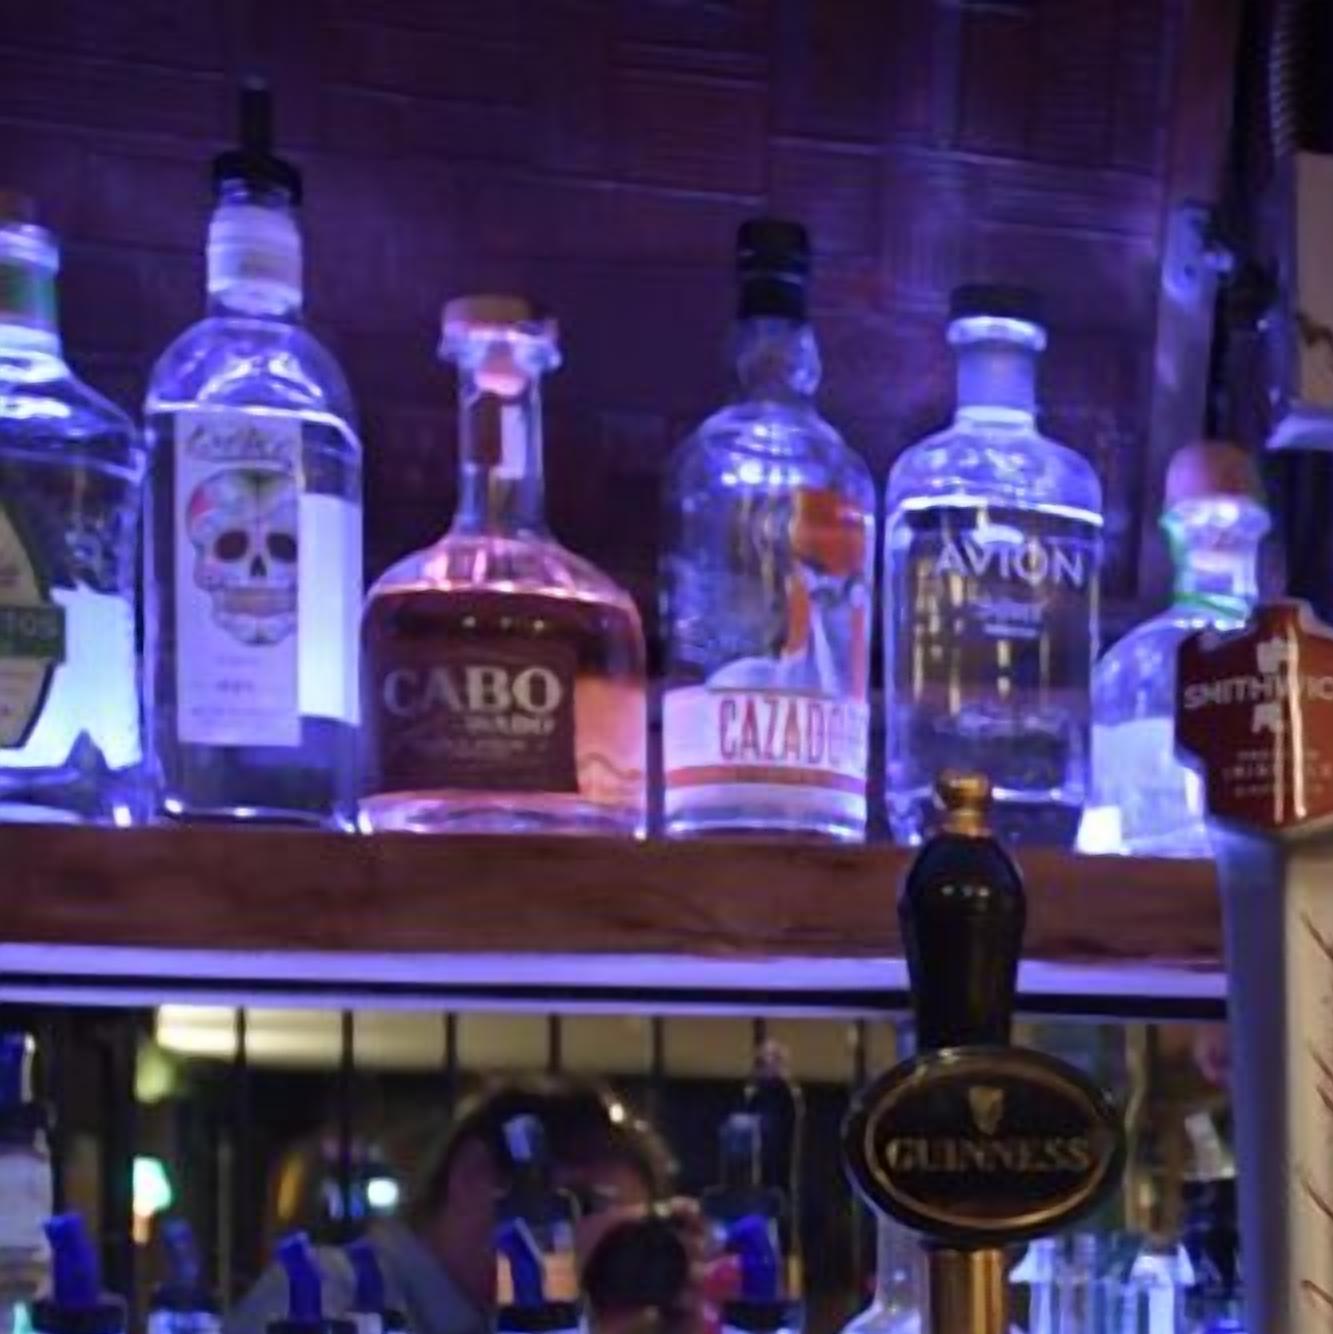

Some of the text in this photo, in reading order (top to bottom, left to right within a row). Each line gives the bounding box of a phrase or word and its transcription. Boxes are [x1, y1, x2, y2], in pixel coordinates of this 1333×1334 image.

[934, 536, 1085, 590] AVION
[382, 665, 563, 716] CABO
[885, 1136, 1093, 1173] GUINNESS
